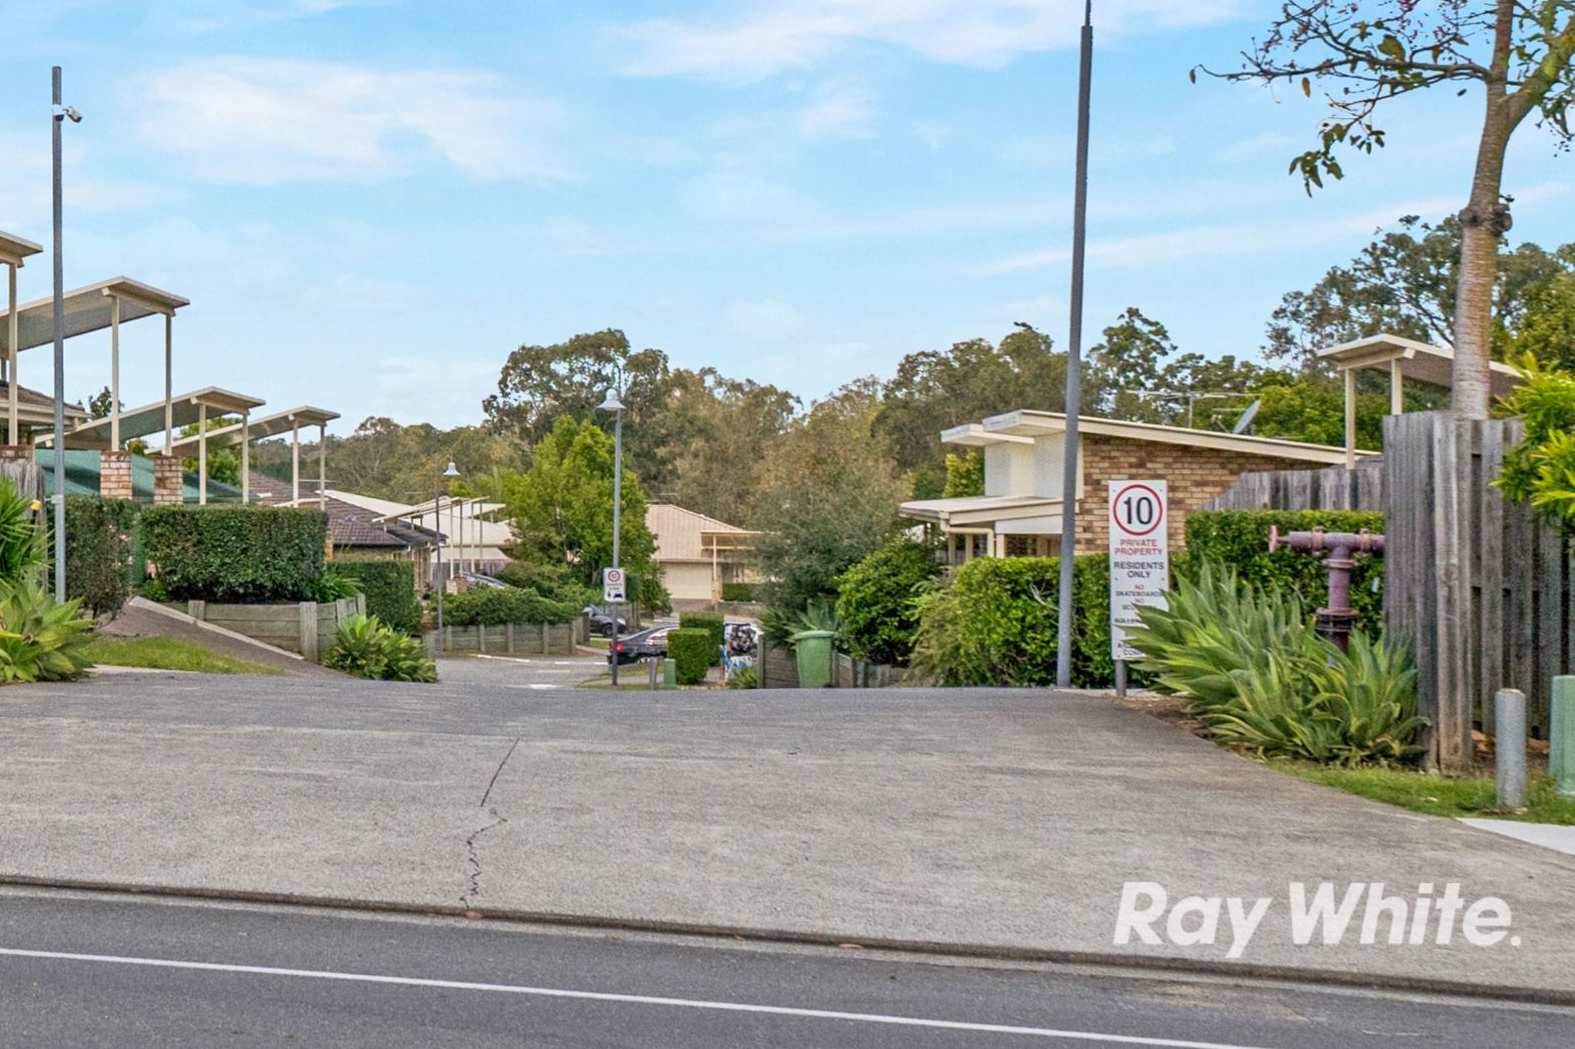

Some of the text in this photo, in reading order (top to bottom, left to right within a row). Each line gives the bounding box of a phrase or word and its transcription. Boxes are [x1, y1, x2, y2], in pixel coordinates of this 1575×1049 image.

[1123, 496, 1153, 525] 10
[1120, 539, 1158, 547] PRIVATE
[1114, 548, 1163, 556] PROPERTY
[1113, 561, 1164, 570] RESIDENTS
[1127, 570, 1151, 579] ONLY
